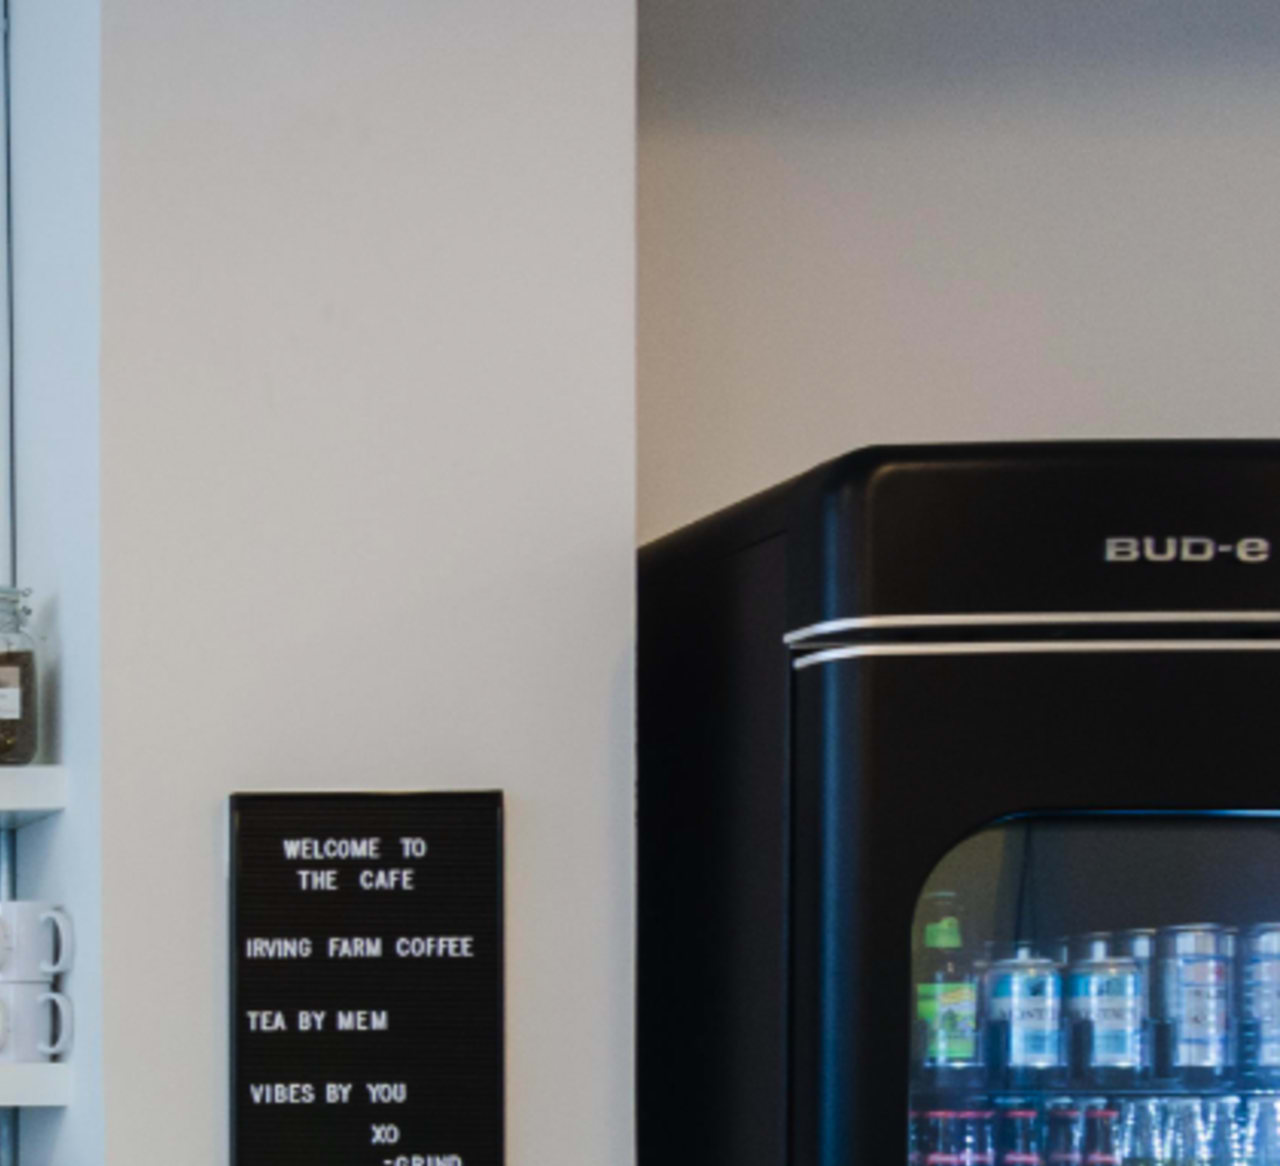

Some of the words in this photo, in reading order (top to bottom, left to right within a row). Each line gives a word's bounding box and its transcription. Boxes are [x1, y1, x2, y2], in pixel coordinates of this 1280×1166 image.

[1105, 537, 1270, 562] BUD-e
[282, 837, 380, 860] WELCOME
[400, 837, 428, 859] TO
[296, 869, 338, 891] THE
[359, 868, 414, 891] CAFE
[246, 937, 313, 959] IRVING
[328, 936, 383, 958] FARM
[395, 936, 474, 958] COFFEE
[246, 1010, 287, 1032] TEA
[297, 1010, 326, 1032] BY
[336, 1010, 388, 1031] MEM
[249, 1082, 316, 1104] VIBES
[325, 1082, 353, 1104] BY
[365, 1082, 407, 1104] YOU
[371, 1123, 400, 1144] XO
